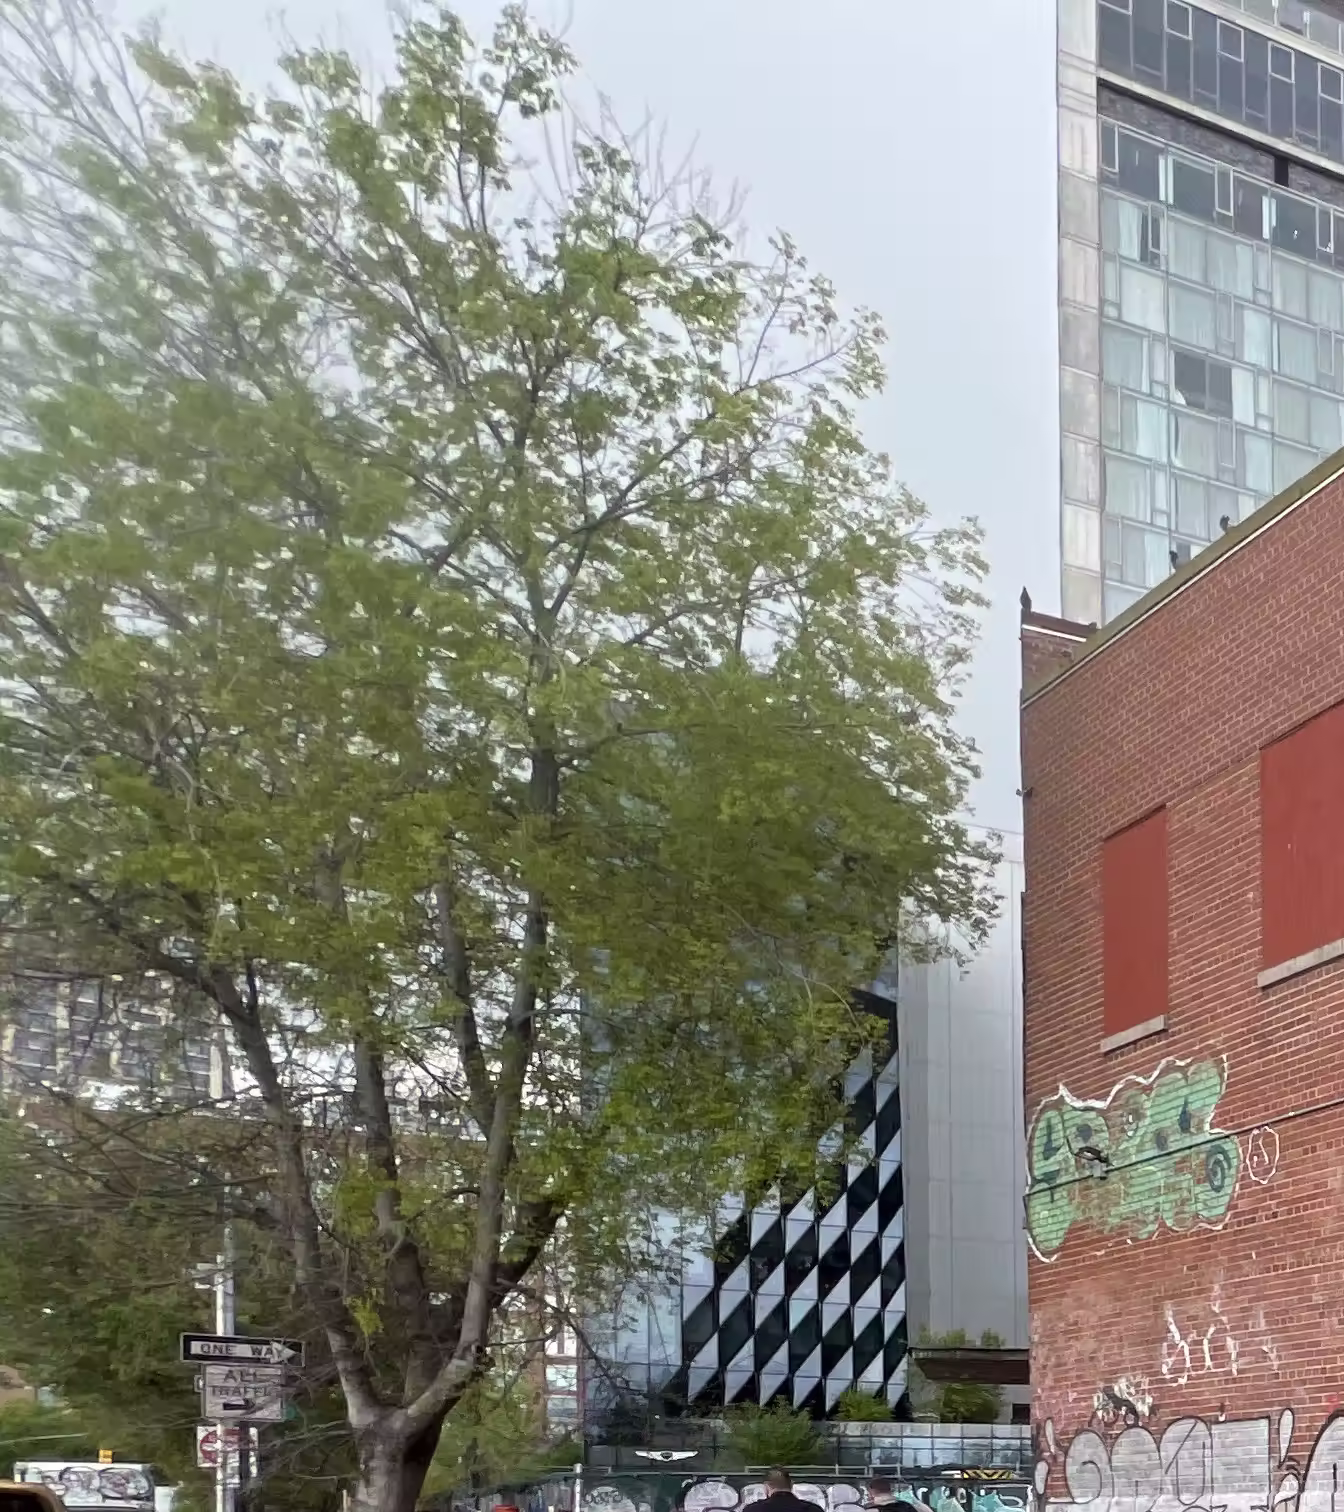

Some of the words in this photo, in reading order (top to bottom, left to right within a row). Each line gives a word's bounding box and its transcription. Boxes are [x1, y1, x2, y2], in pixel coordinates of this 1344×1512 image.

[201, 1343, 237, 1355] ONE
[224, 1369, 265, 1383] ALL
[211, 1385, 277, 1398] TRAFFI
